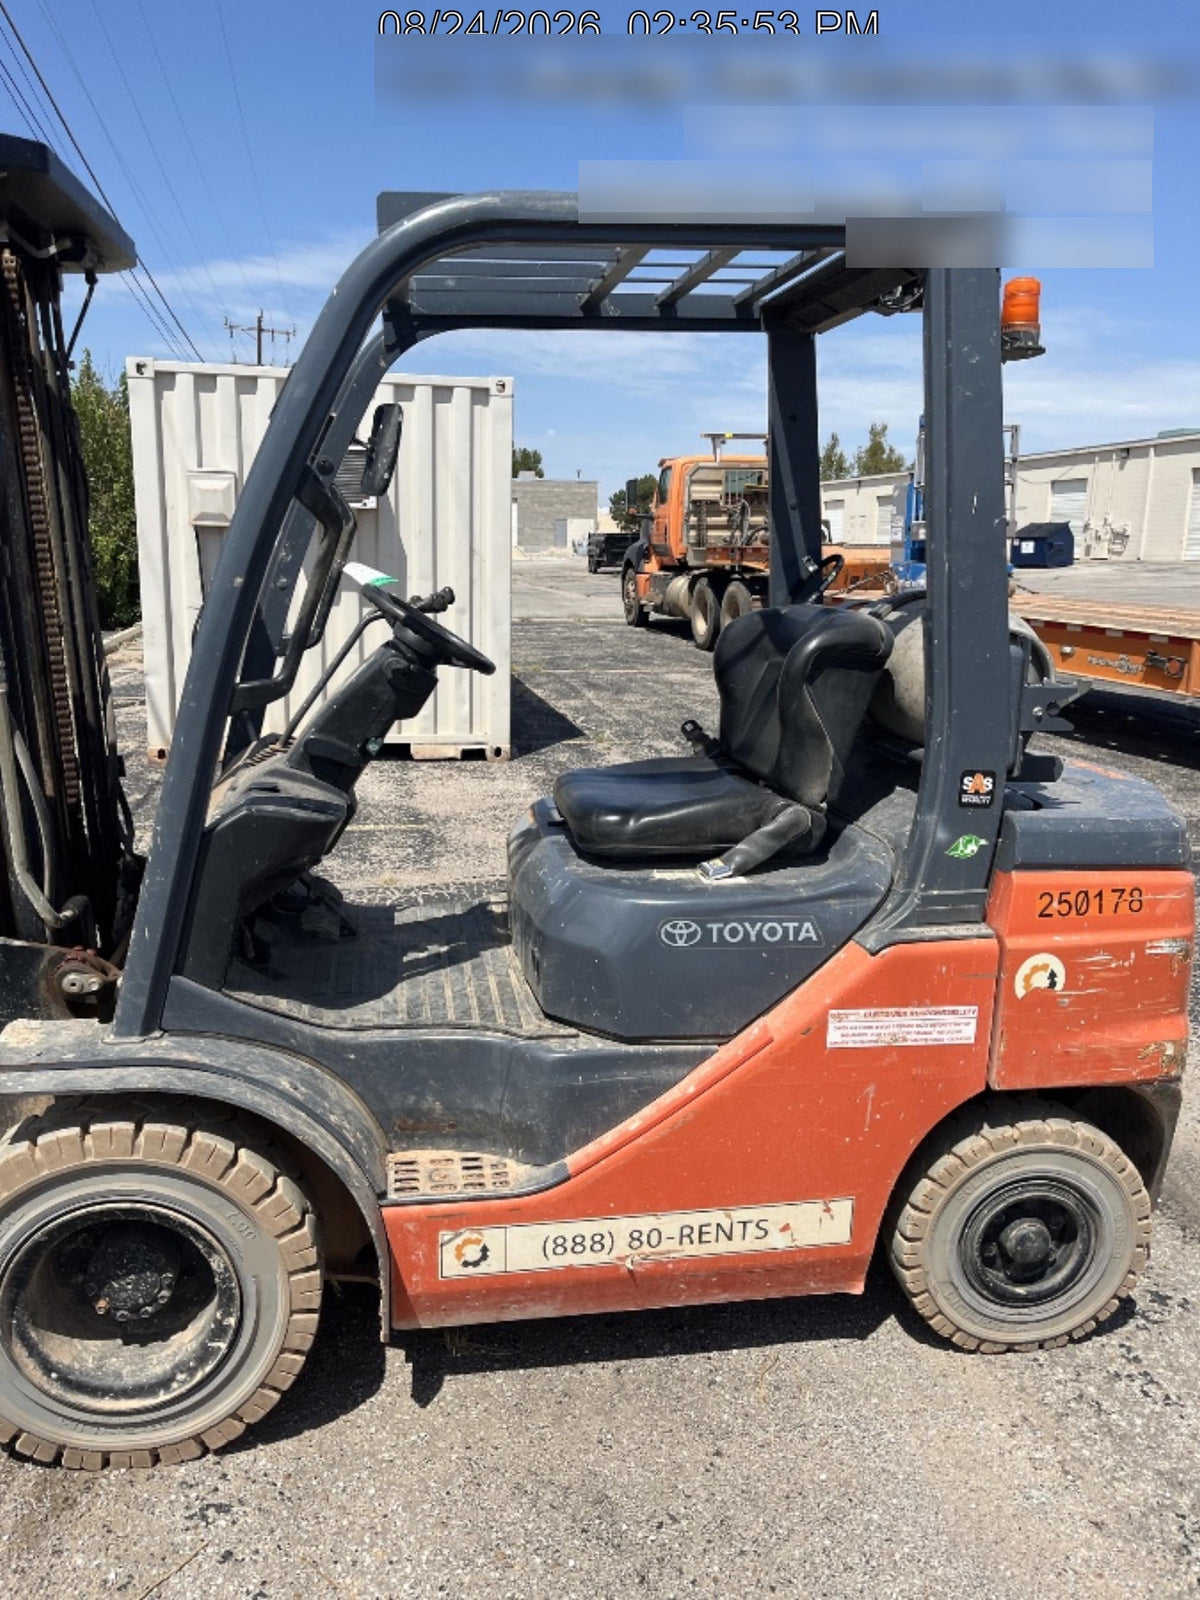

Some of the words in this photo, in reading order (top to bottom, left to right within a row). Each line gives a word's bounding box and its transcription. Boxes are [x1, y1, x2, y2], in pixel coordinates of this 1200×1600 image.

[962, 773, 993, 793] SAS
[1038, 887, 1144, 917] 250178
[707, 921, 818, 943] TOYOTA
[542, 1231, 615, 1261] (888)
[628, 1218, 770, 1251] 80-RENTS
